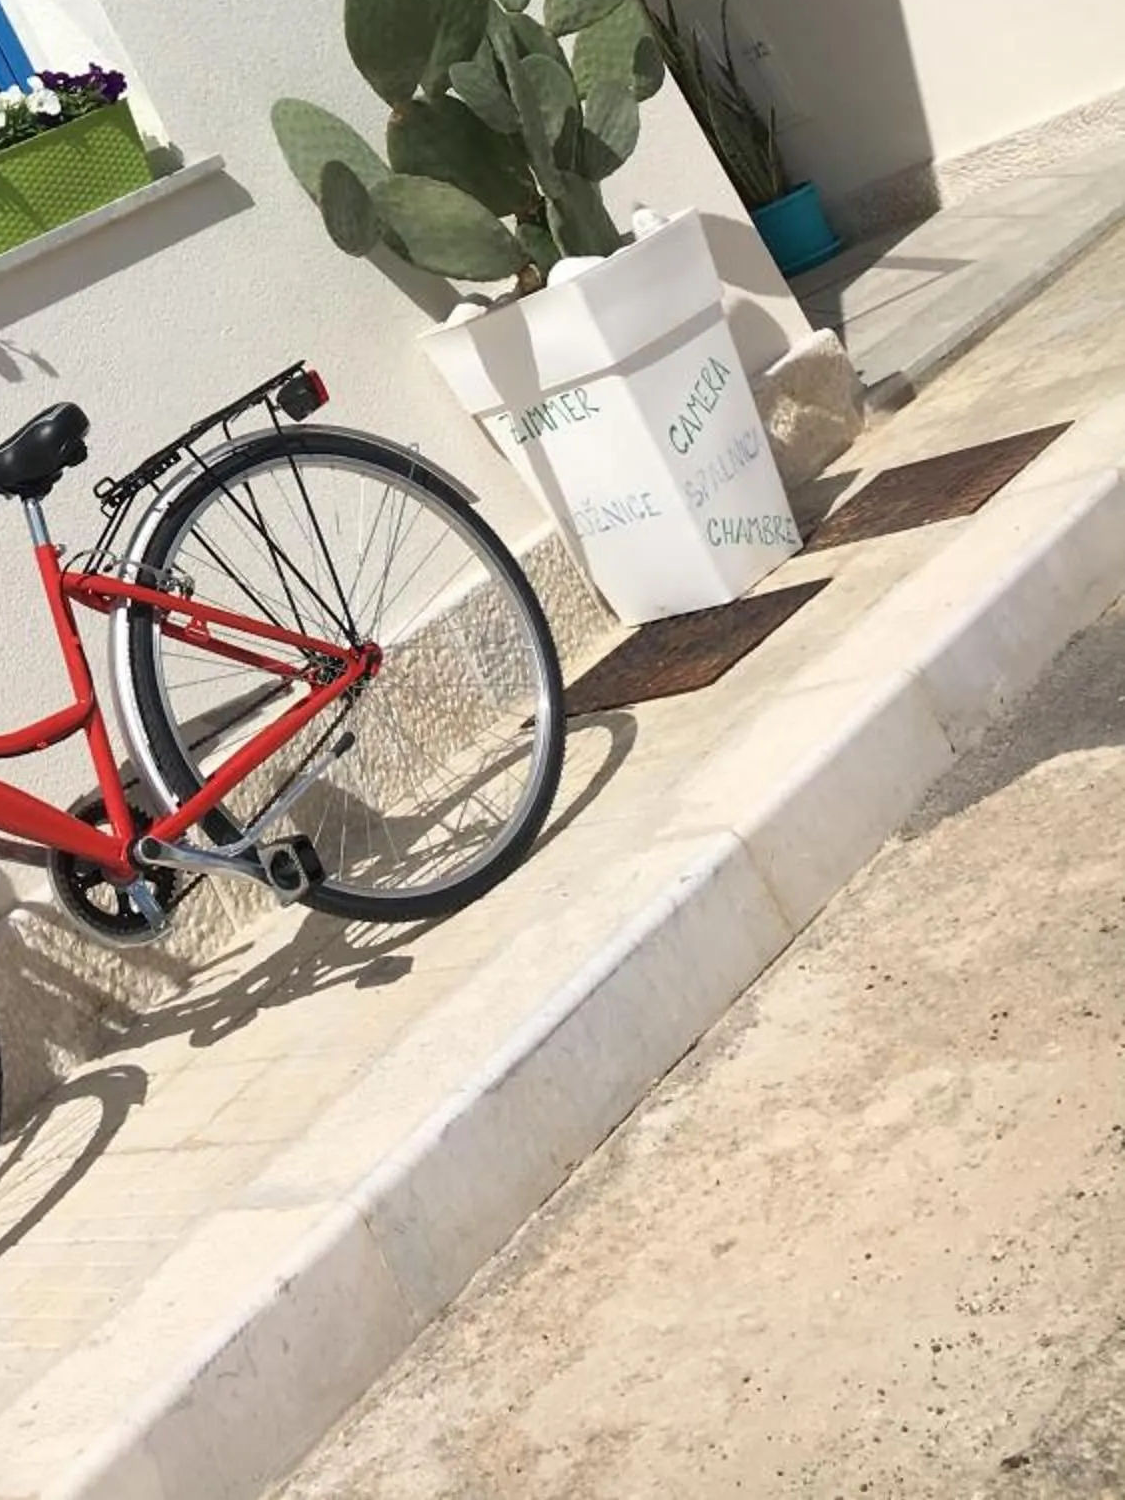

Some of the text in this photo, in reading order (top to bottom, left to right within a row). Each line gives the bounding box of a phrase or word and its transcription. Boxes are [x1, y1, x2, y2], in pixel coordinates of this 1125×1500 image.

[498, 387, 600, 446] ZIMMER
[668, 356, 731, 455] CAMERA
[707, 514, 798, 547] CHAMBRE
